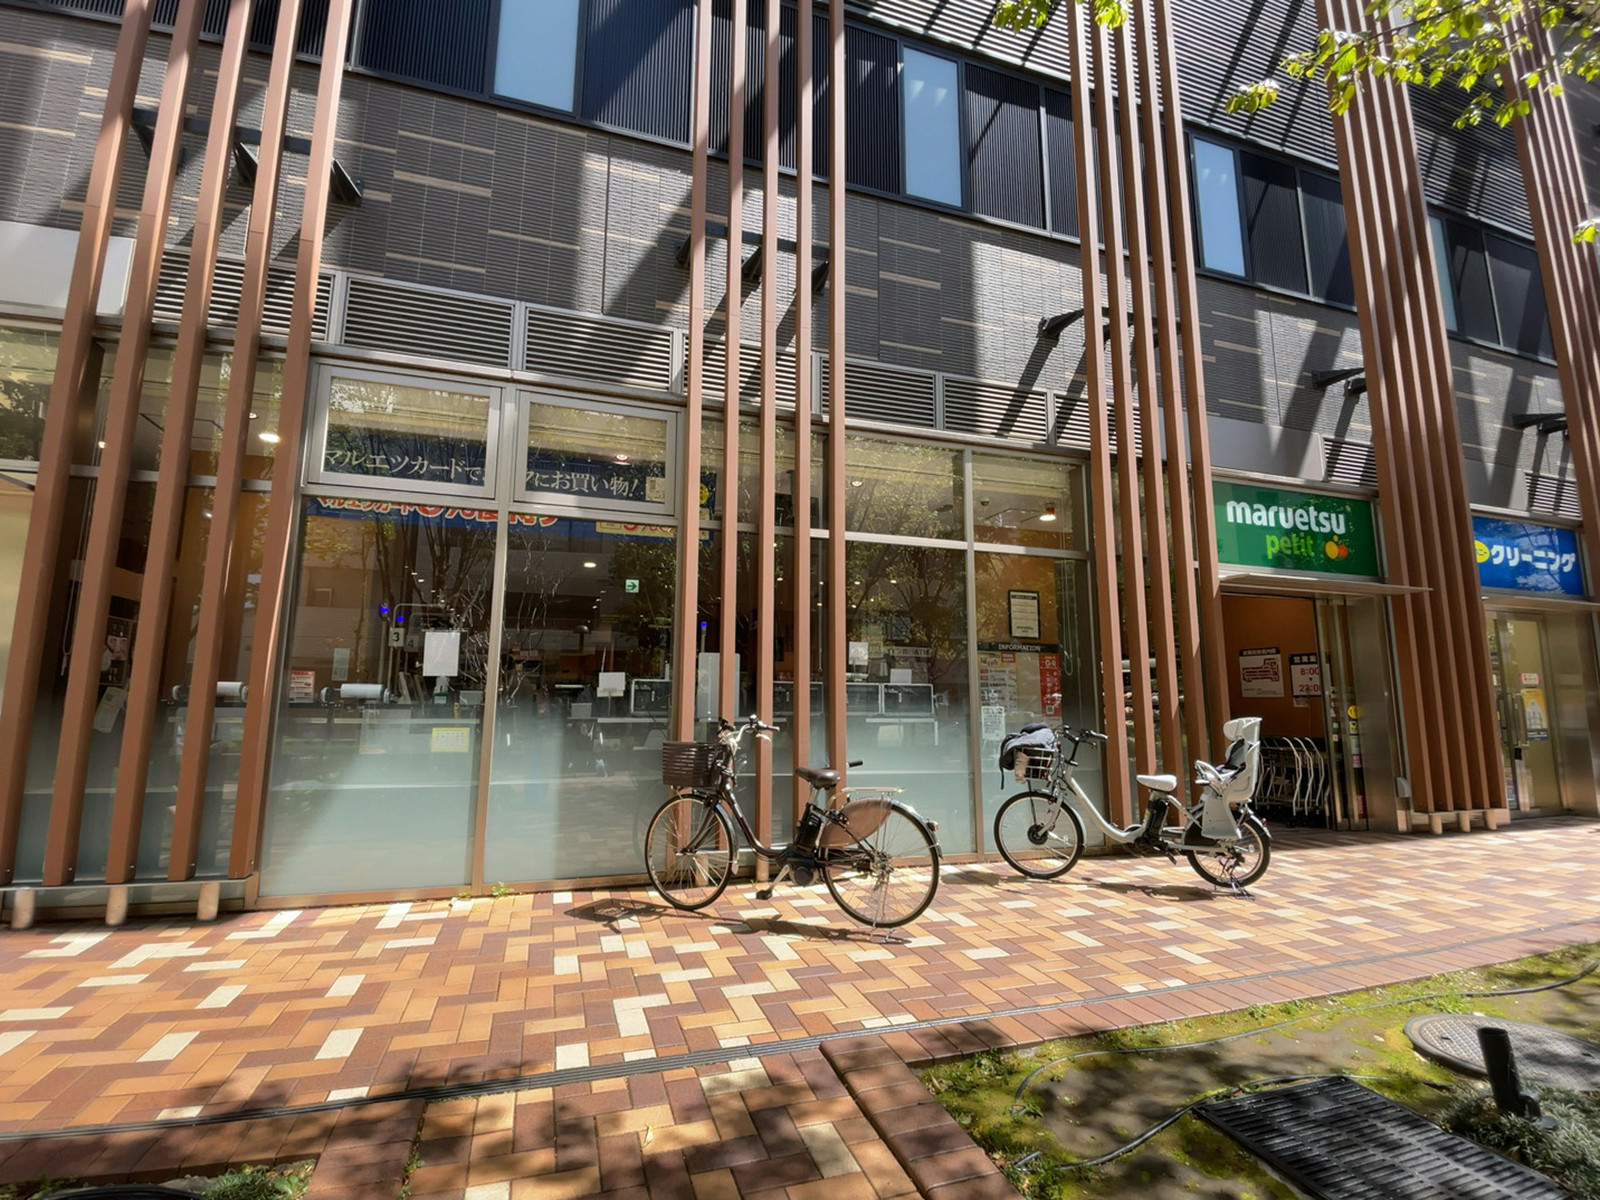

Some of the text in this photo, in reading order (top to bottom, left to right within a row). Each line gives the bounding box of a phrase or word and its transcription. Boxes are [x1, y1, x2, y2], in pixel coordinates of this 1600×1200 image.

[1226, 500, 1346, 535] maruetsu
[1265, 533, 1314, 560] petit
[1490, 544, 1576, 573] クリーニング
[392, 631, 400, 642] 3
[998, 643, 1041, 652] INFORMATION
[1298, 684, 1321, 693] 22:0
